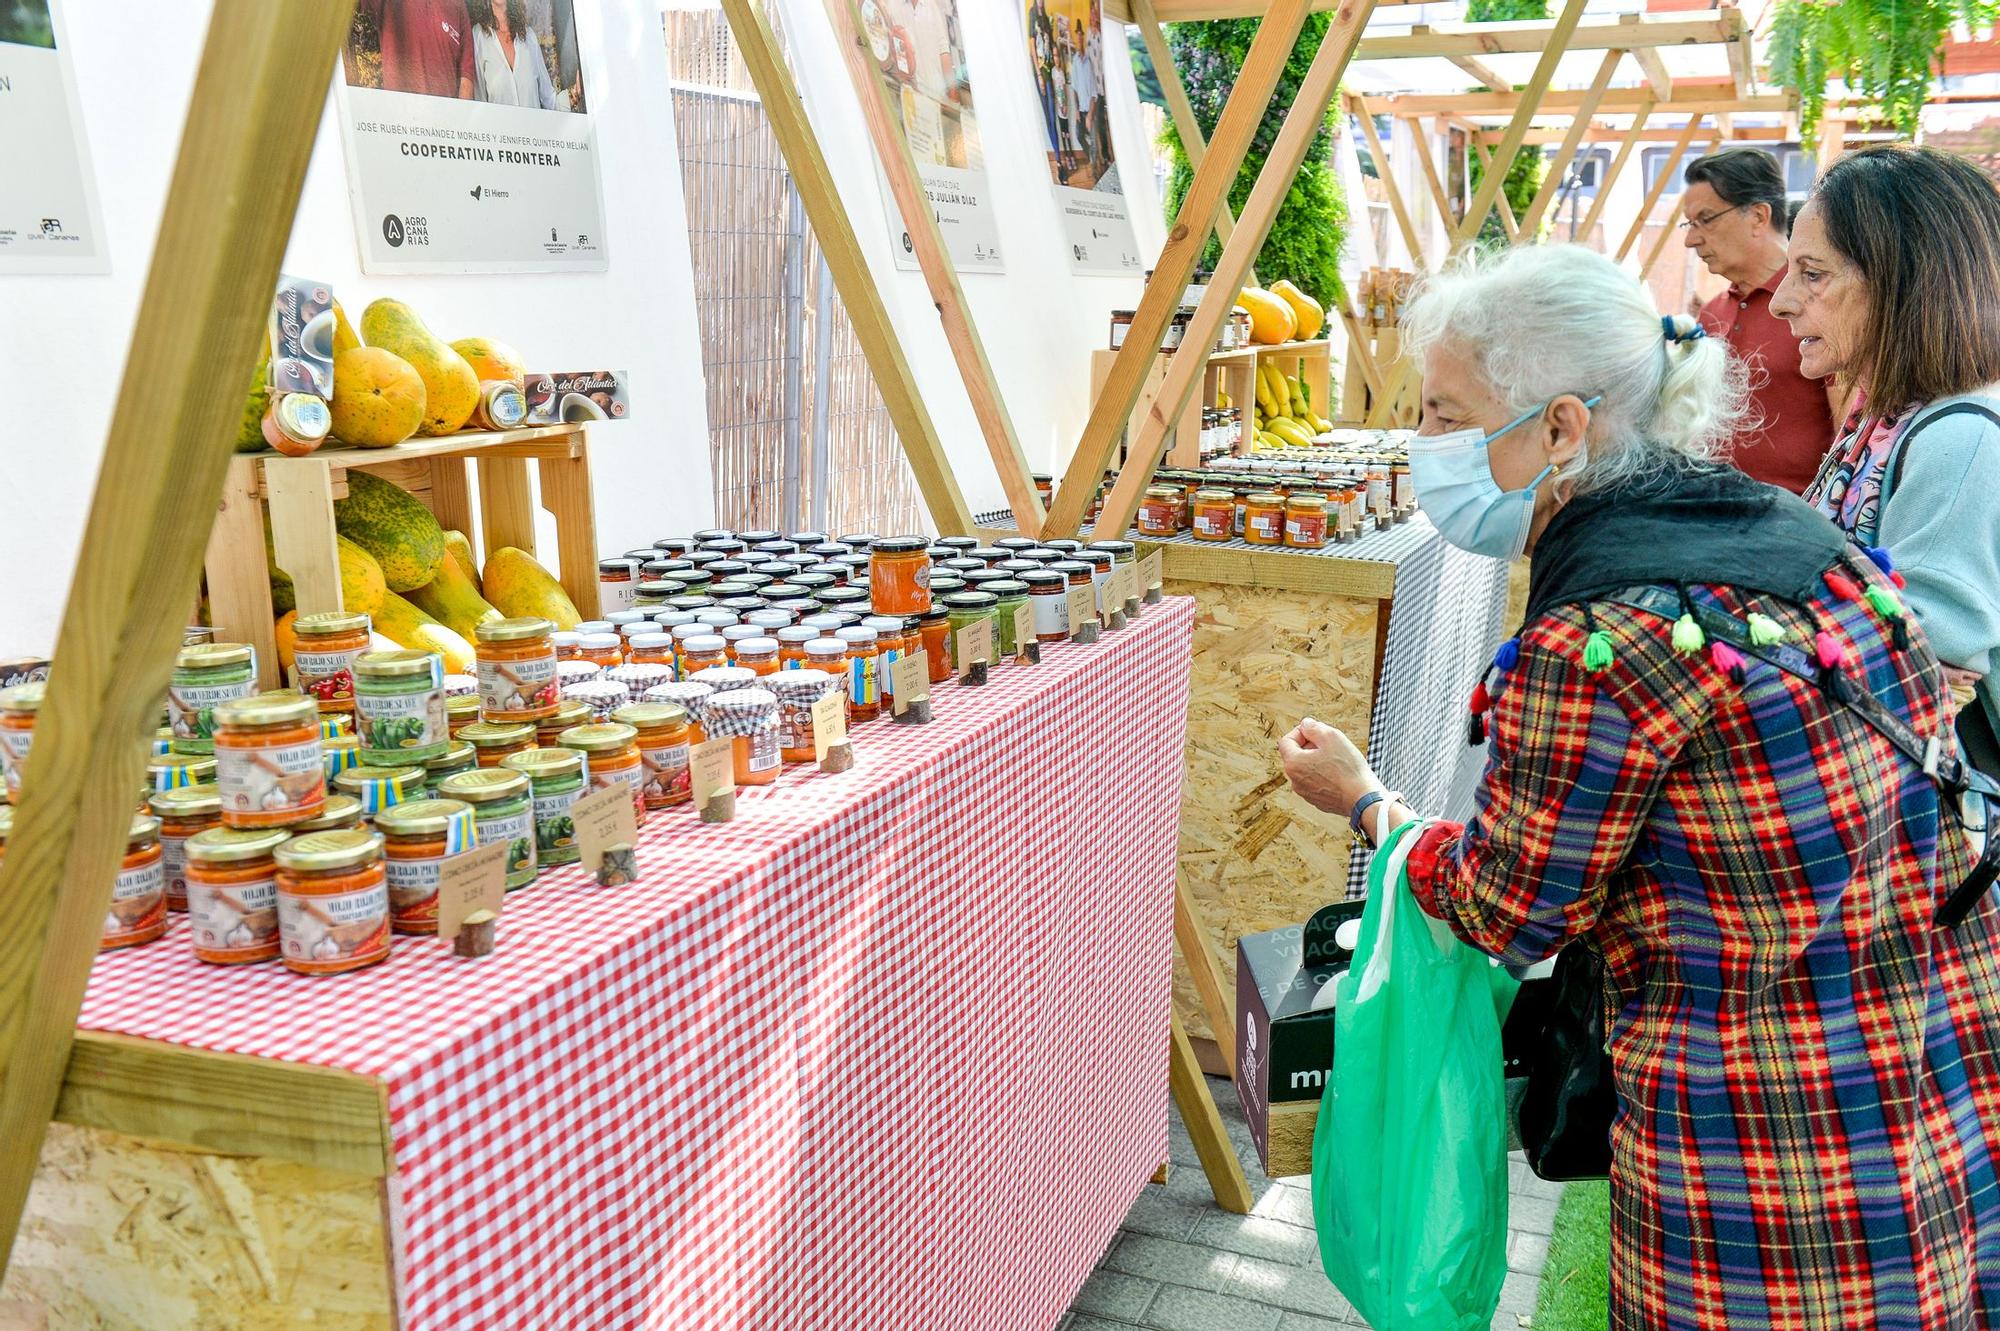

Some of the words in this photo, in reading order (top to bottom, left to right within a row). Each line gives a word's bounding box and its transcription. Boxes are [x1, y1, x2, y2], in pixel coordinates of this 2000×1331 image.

[457, 131, 490, 142] MORALES
[500, 135, 531, 145] JENNIFER
[533, 138, 565, 148] QUINTERO
[401, 142, 494, 162] COOPERATIVA
[498, 150, 561, 167] FRONTERA
[405, 216, 427, 226] AGRO
[406, 226, 428, 236] CANA
[407, 236, 430, 246] RIAS
